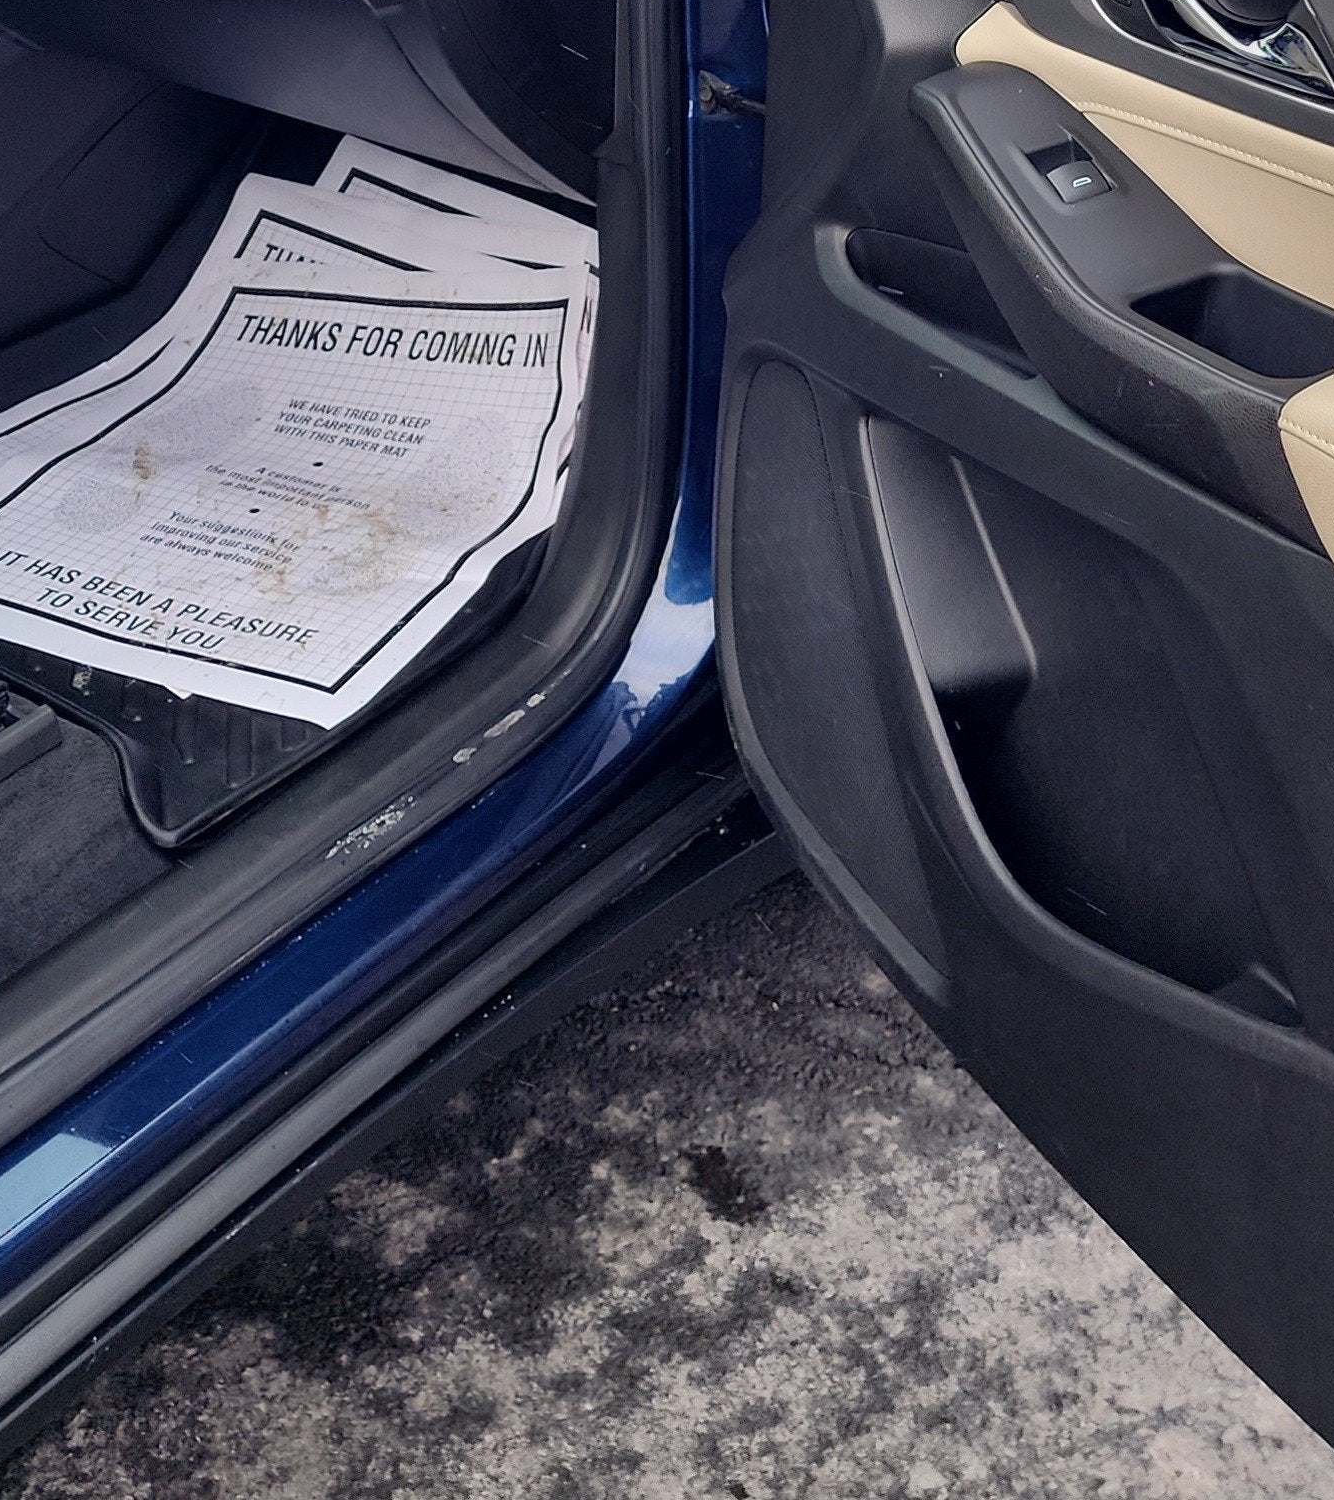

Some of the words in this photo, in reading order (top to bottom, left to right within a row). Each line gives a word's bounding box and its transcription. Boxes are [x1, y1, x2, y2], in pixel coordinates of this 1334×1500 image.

[237, 314, 343, 352] THANKS
[344, 324, 403, 360] FOR
[408, 329, 517, 367] COMING
[523, 332, 549, 368] IN
[278, 411, 312, 425] YOUR
[313, 417, 382, 439] CARPETING
[383, 429, 425, 445] CLEAN
[288, 399, 309, 410] WE
[309, 402, 343, 416] HAVE
[343, 407, 379, 422] TRIED
[379, 412, 397, 426] TO
[398, 416, 431, 430] KEEP
[273, 424, 307, 438] WITH
[308, 430, 338, 444] THIS
[338, 436, 380, 452] PAPER
[380, 444, 409, 458] MAT
[205, 463, 226, 475] the
[227, 469, 262, 484] most
[261, 478, 326, 501] important
[257, 488, 298, 503] world
[267, 469, 328, 490] customer
[139, 532, 163, 545] are
[164, 538, 212, 557] always
[150, 520, 218, 545] improving
[218, 538, 244, 549] our
[243, 542, 293, 564] service
[169, 510, 200, 526] Your
[199, 519, 279, 544] suggestions
[278, 537, 301, 552] for
[24, 558, 82, 585] HAS
[81, 576, 154, 608] BEEN
[153, 598, 176, 614] A
[177, 603, 320, 645] PLEASURE
[35, 587, 75, 609] TO
[74, 600, 166, 637] SERVE
[167, 625, 227, 651] YOU
